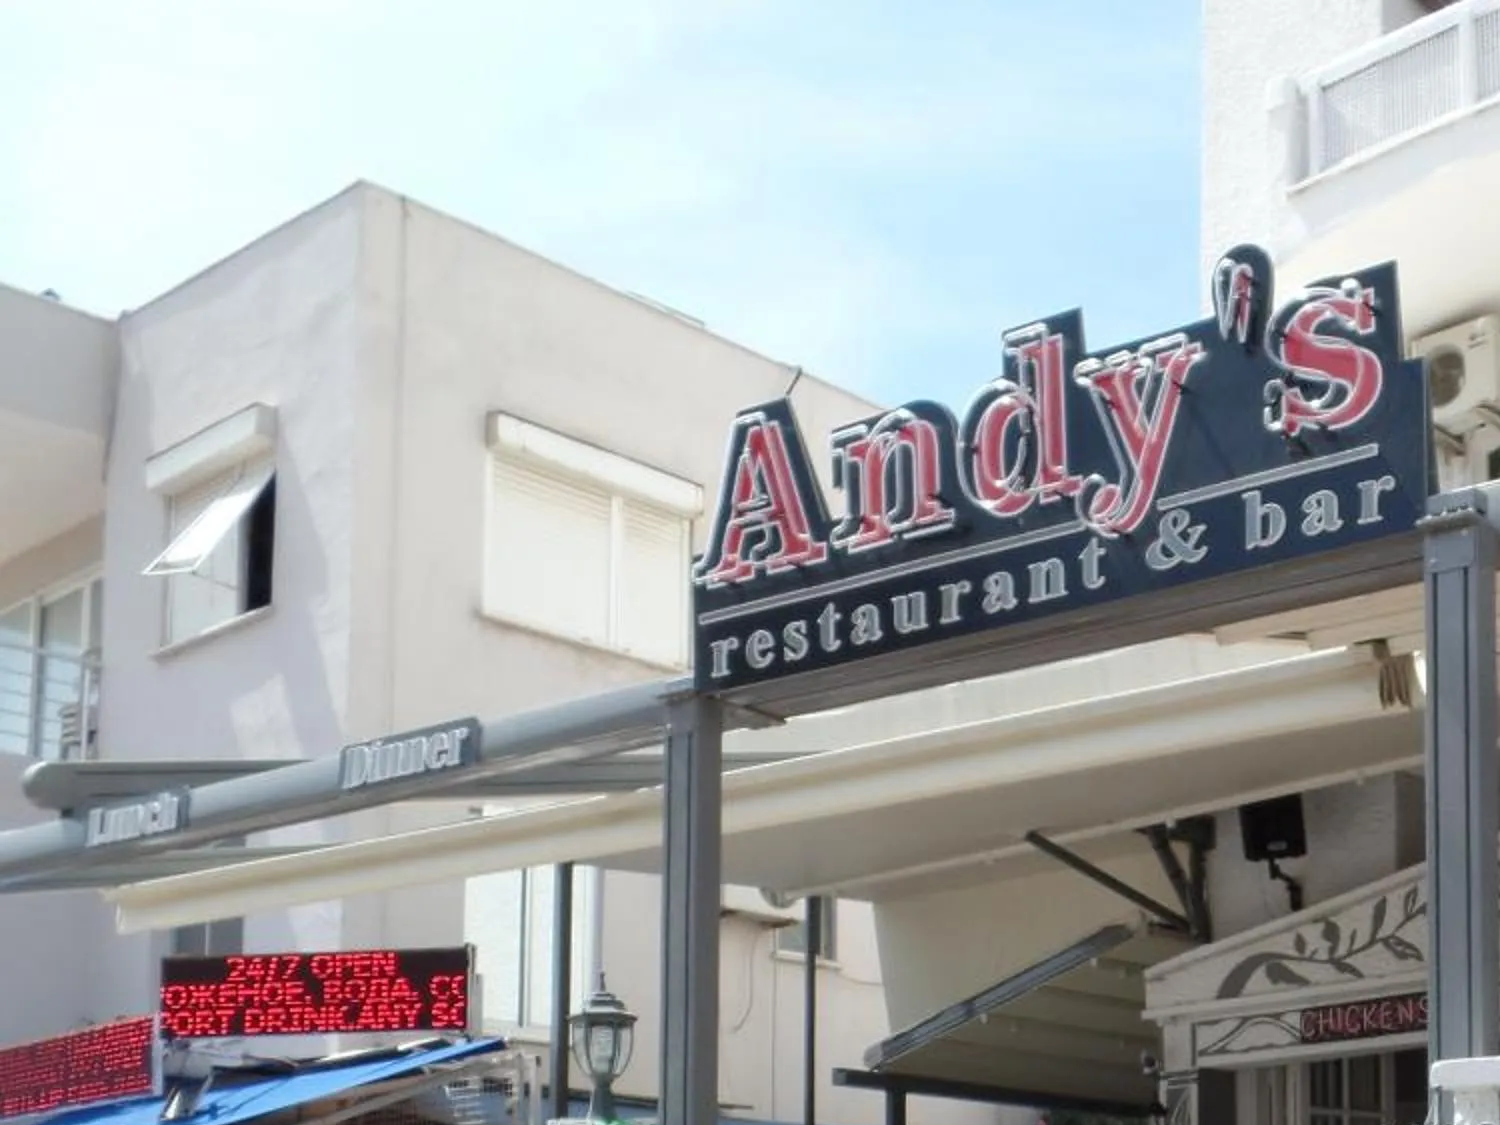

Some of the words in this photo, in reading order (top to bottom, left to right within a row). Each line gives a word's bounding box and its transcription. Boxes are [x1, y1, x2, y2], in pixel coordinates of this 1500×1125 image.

[693, 257, 1384, 588] Andy's
[709, 537, 1107, 679] restaurant
[1144, 508, 1208, 570] &
[1240, 473, 1397, 550] bar
[342, 727, 470, 789] Dinner
[227, 956, 301, 981] 24/7
[310, 952, 396, 979] OPEN
